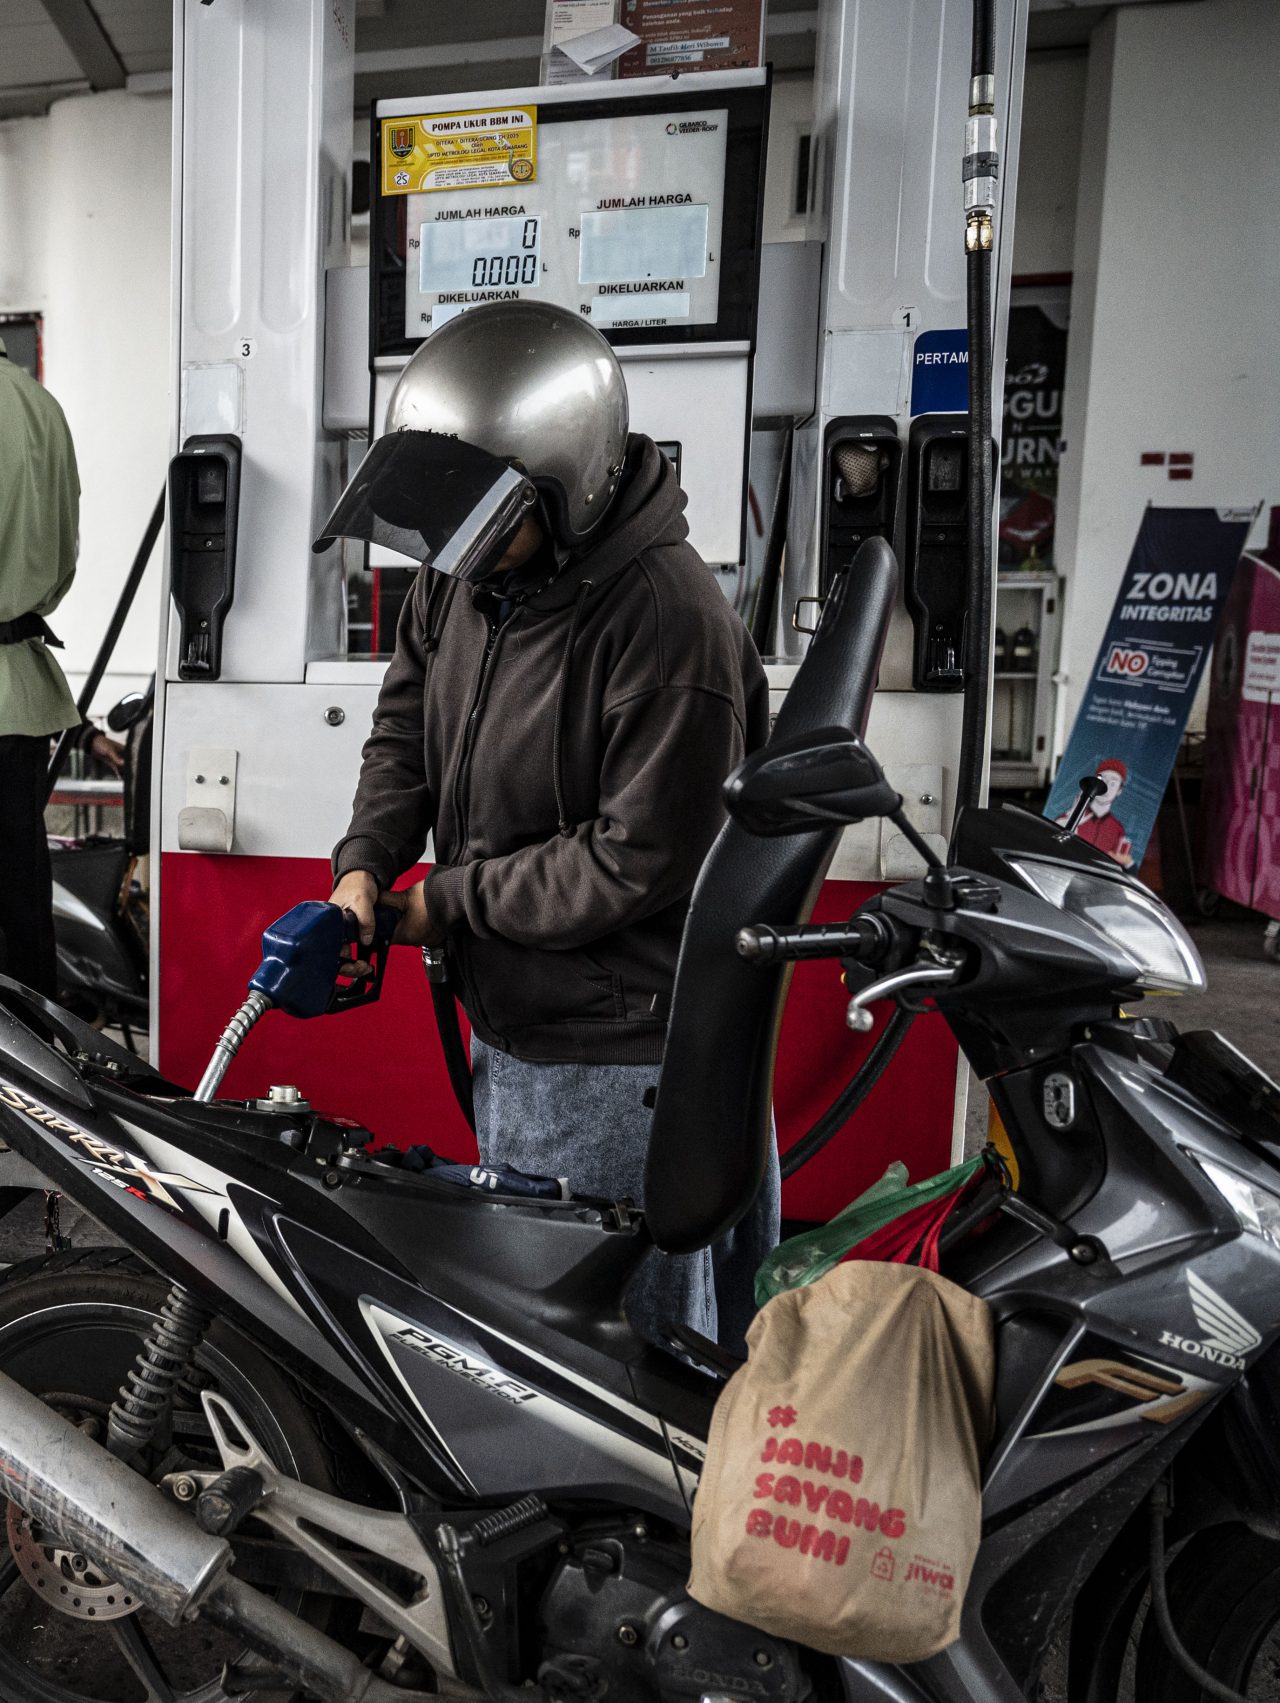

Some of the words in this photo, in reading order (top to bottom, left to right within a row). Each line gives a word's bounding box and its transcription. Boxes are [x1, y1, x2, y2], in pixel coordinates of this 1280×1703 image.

[432, 121, 460, 132] POMPA
[463, 119, 487, 129] UKUR
[490, 116, 509, 126] BBM
[511, 115, 524, 124] INI
[436, 138, 455, 146] DITERA
[441, 149, 470, 157] METROLOGI
[597, 196, 645, 209] JUMLAH
[649, 193, 693, 205] HARGA
[435, 208, 481, 221] JUMLAH
[484, 205, 526, 217] HARGA
[408, 238, 420, 249] Rp
[522, 219, 538, 249] 0
[568, 228, 580, 239] Rp
[709, 252, 714, 261] L
[472, 254, 537, 287] 0.000
[542, 263, 548, 272] L
[598, 280, 684, 295] DIKELUARKAN
[438, 290, 519, 304] DIKELUARKAN
[580, 304, 592, 314] Rp
[420, 312, 432, 323] Rp
[612, 320, 639, 328] HARGA
[645, 318, 667, 326] LITER
[902, 312, 911, 328] 1
[241, 343, 251, 357] 3
[1003, 390, 1059, 419] GU
[1126, 572, 1217, 601] ZONA
[1120, 605, 1213, 623] INTEGRITAS
[1107, 648, 1148, 676] NO
[1158, 1330, 1246, 1371] HONDA
[389, 1333, 431, 1359] FUEL
[435, 1358, 523, 1405] INJECTION
[760, 1436, 864, 1484] JANJI
[753, 1472, 906, 1539] SAYANG
[745, 1508, 851, 1567] BUMI
